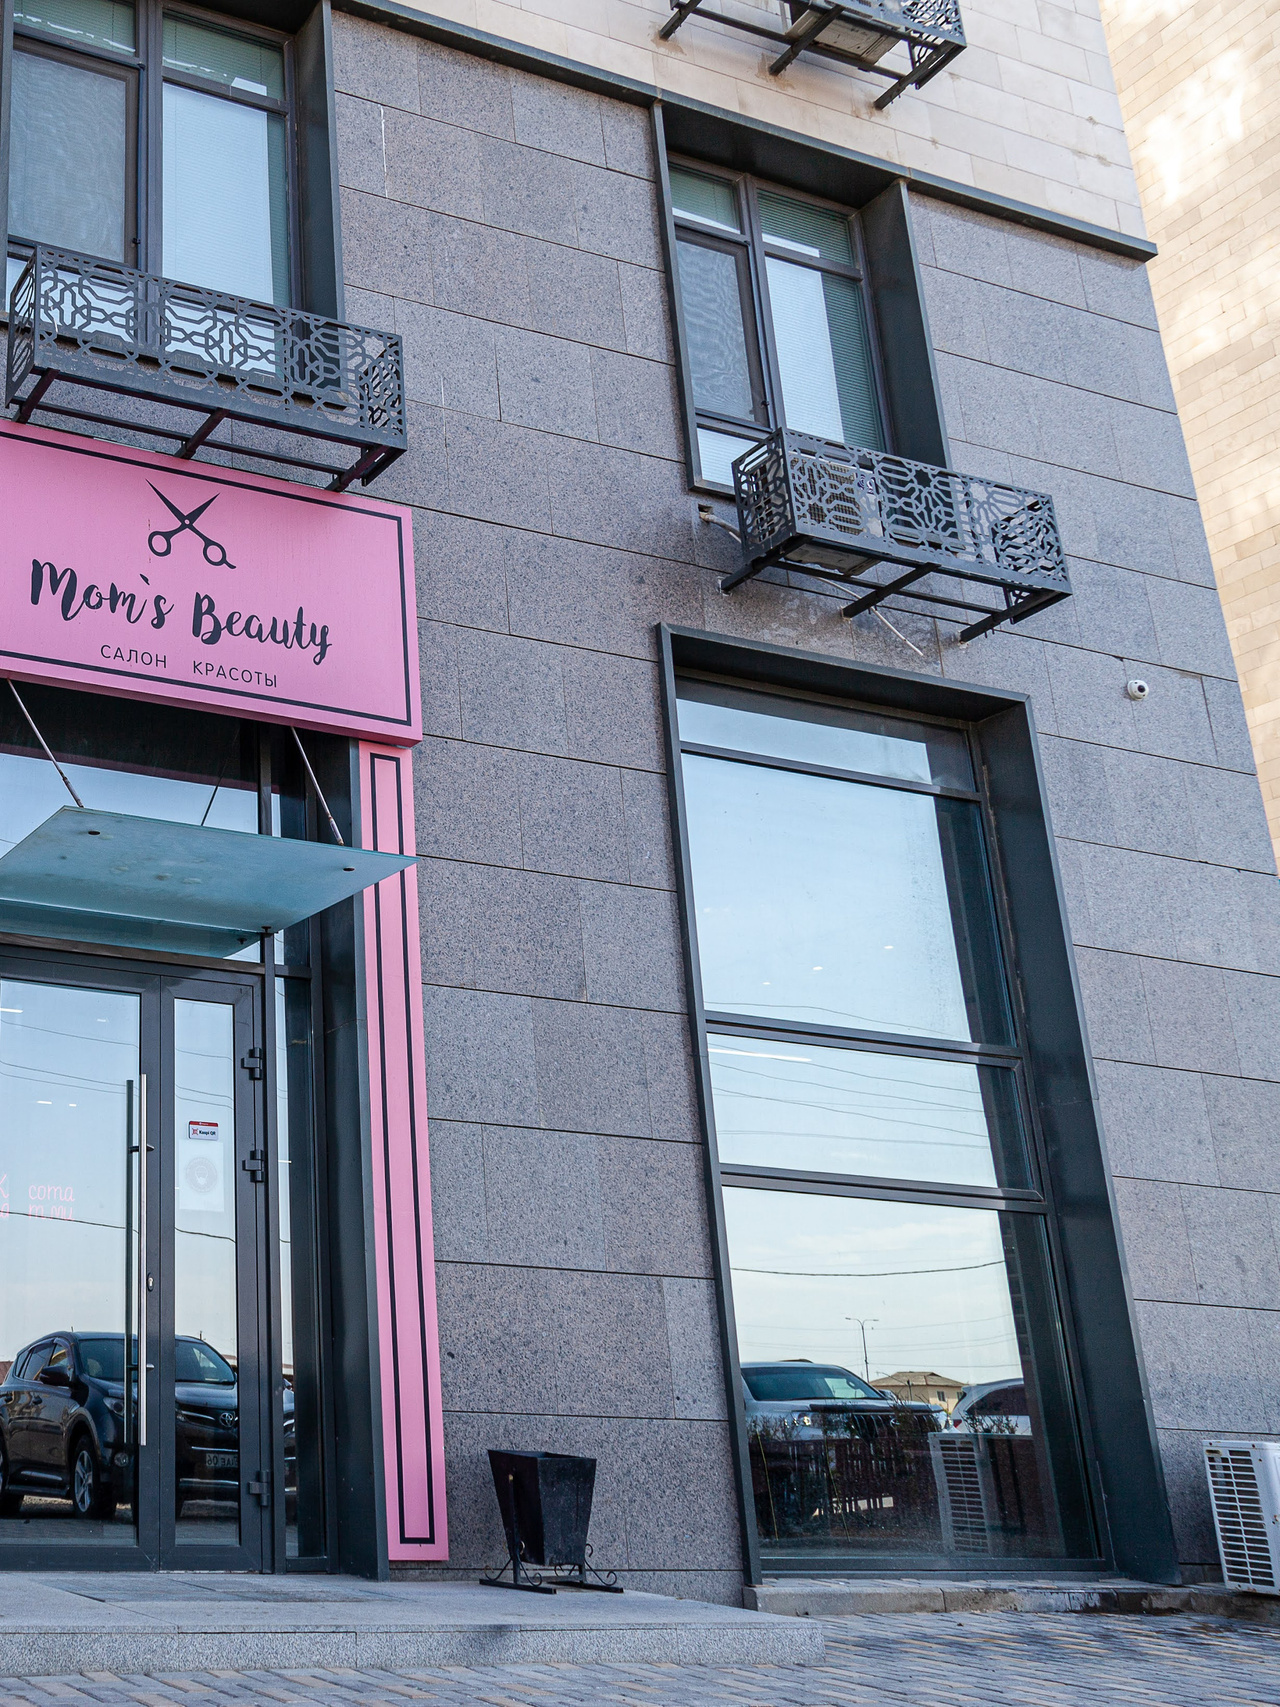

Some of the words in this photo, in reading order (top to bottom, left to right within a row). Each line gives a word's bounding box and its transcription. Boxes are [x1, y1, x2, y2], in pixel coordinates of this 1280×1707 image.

[192, 591, 332, 665] Beauty
[100, 643, 167, 669] САЛОН
[192, 659, 278, 688] КРАСОТЫ
